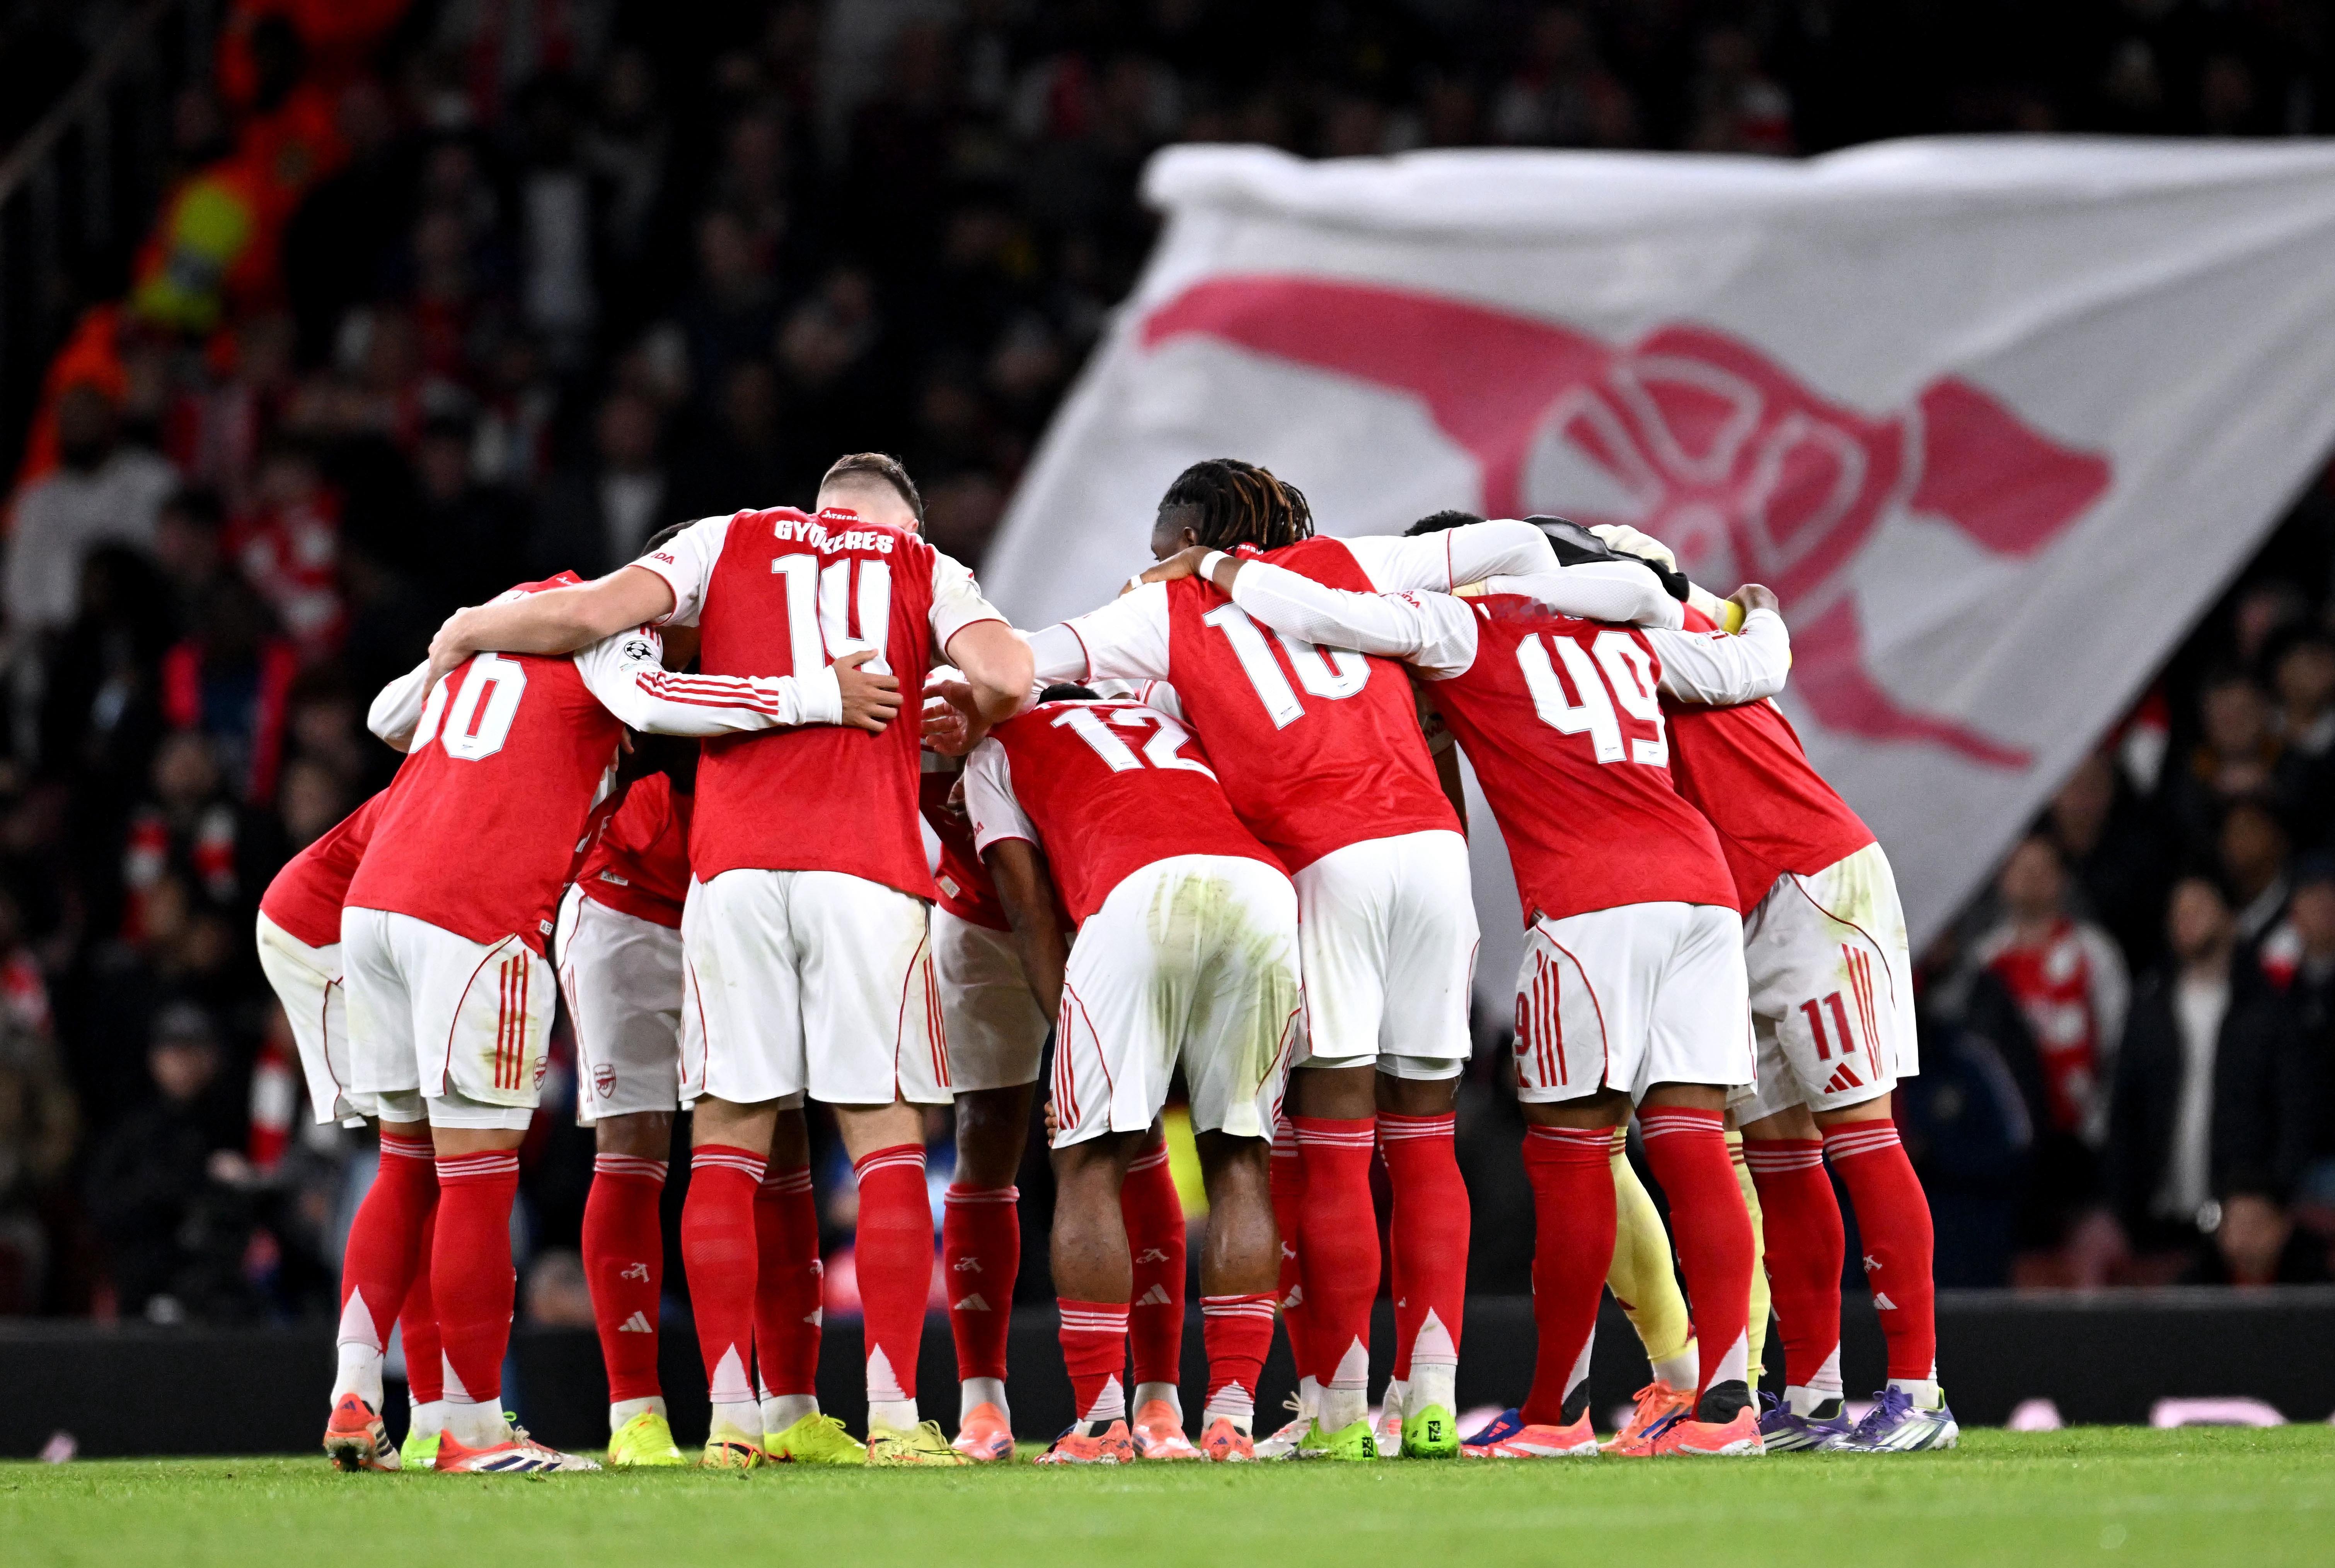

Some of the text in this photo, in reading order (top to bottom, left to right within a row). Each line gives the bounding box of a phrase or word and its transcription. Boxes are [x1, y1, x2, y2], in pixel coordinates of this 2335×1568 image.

[772, 553, 892, 677] 14
[1050, 706, 1220, 784] 12
[1515, 631, 1669, 768] 49
[1800, 990, 1856, 1062] 11
